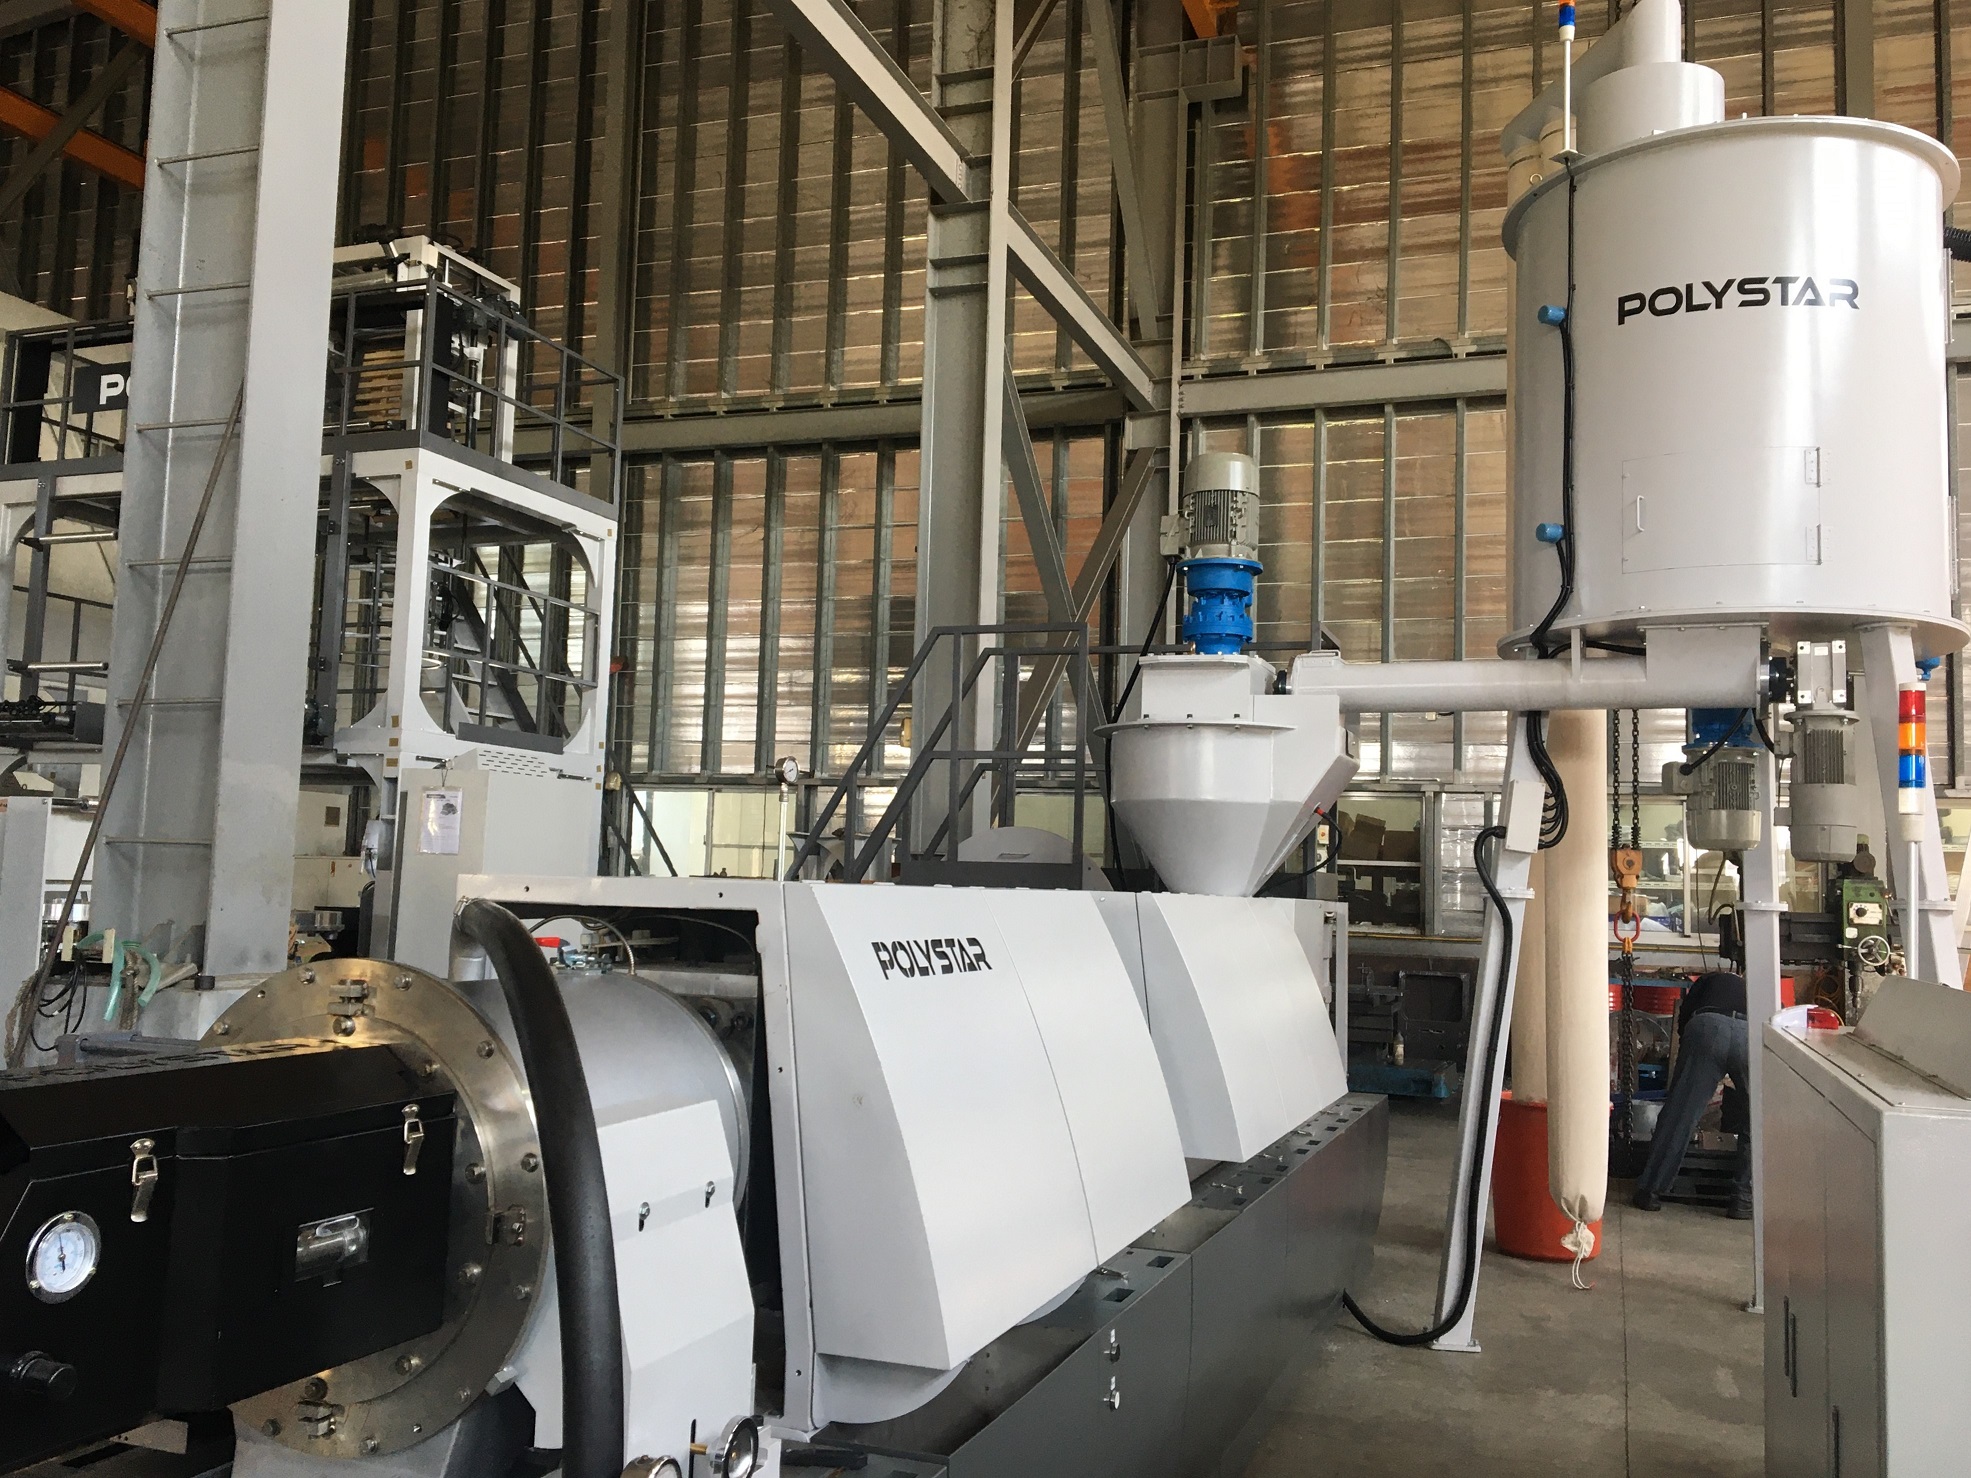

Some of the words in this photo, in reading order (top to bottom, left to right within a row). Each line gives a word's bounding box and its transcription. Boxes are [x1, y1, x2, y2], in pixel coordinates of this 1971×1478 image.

[1618, 276, 1860, 326] POLYSTAR
[100, 373, 131, 405] P
[871, 937, 992, 980] POLYSTAR
